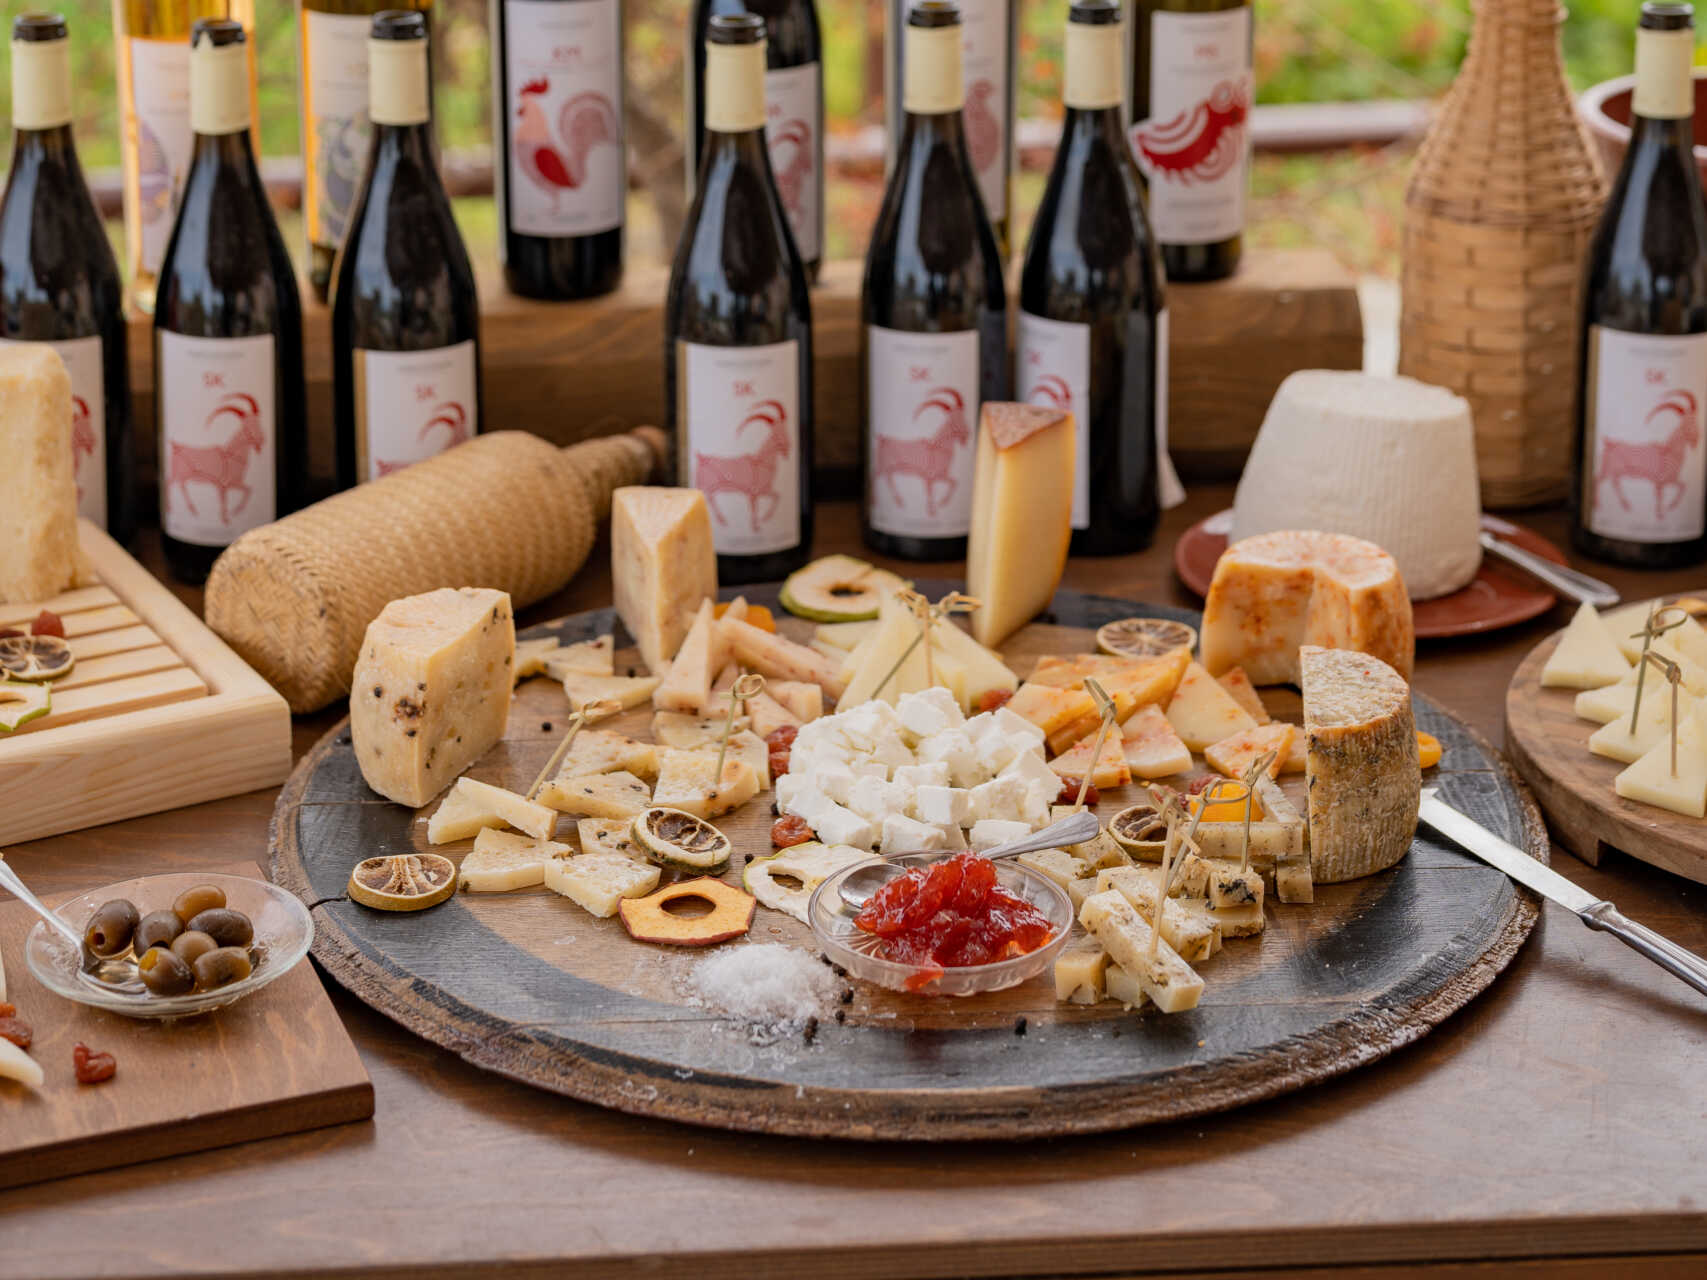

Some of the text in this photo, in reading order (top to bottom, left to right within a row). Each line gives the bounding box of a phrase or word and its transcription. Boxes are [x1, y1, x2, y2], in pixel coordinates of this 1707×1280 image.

[203, 372, 225, 389] SK
[909, 367, 929, 384] SK
[416, 383, 438, 402] SK
[733, 380, 755, 397] SK
